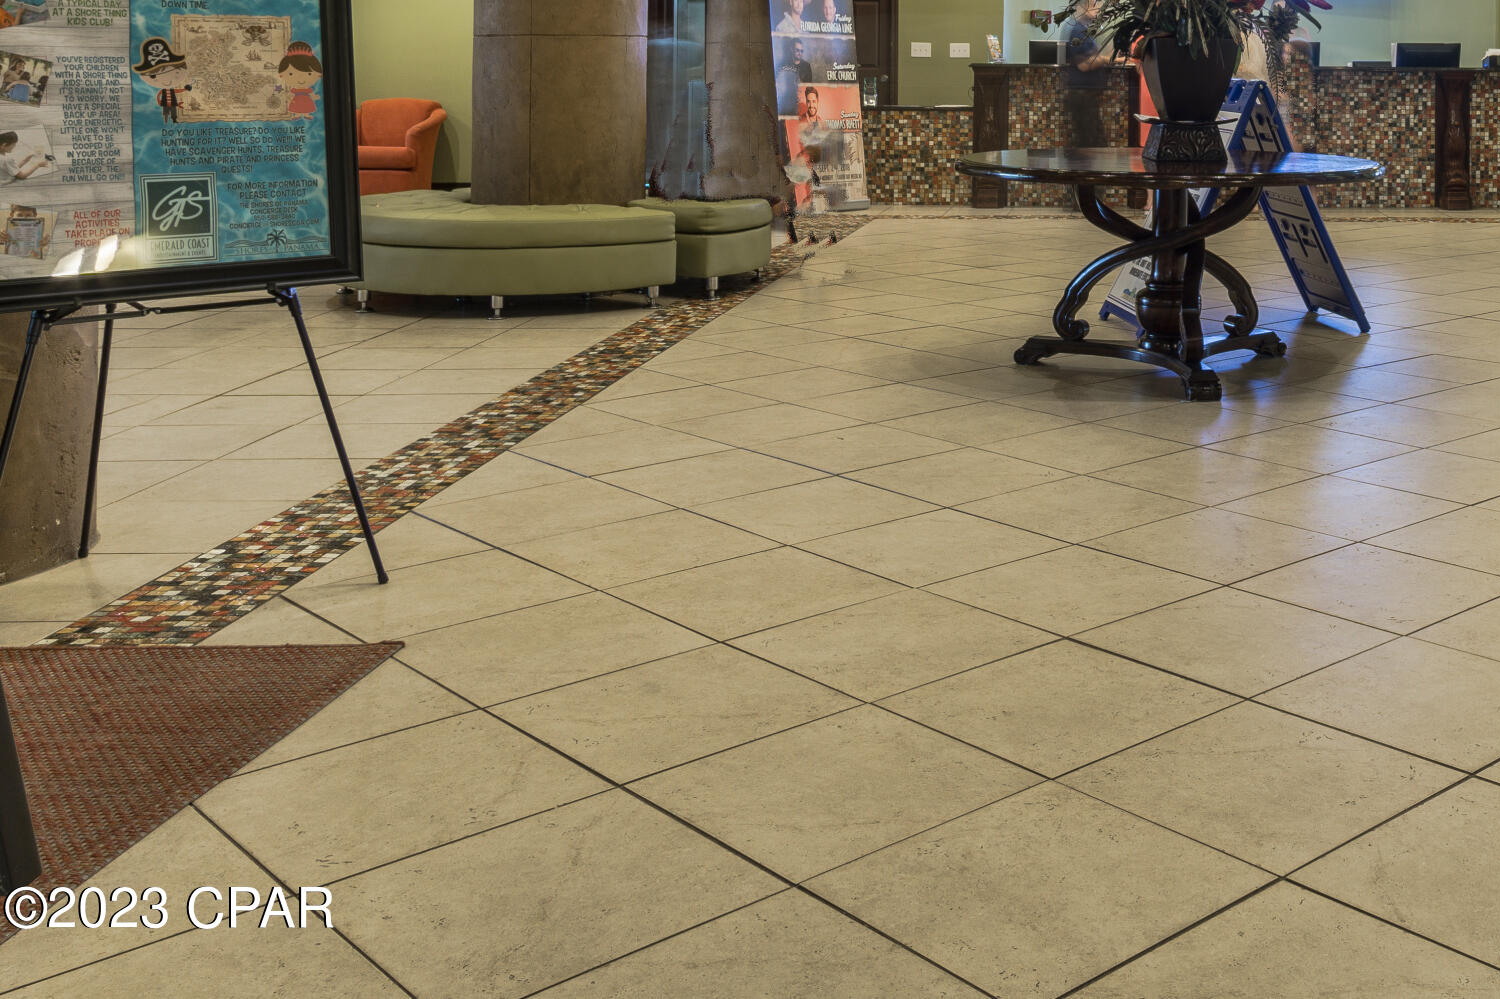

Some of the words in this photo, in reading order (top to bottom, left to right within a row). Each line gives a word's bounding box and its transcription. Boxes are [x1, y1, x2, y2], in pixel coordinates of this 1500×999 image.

[66, 0, 102, 8] TYPICAL
[53, 8, 64, 16] AT
[75, 8, 101, 17] SHORE
[67, 17, 87, 26] KIDS
[835, 14, 851, 23] Friday
[800, 21, 820, 32] FLORIDA
[821, 22, 841, 33] GEORGIA
[842, 24, 853, 33] LINE
[833, 62, 855, 70] Saturday
[827, 71, 837, 80] ERIC
[838, 71, 856, 80] CHURCH
[215, 127, 256, 135] TREASURE?
[162, 138, 195, 146] HUNTING
[170, 158, 196, 166] HUNTS
[199, 156, 214, 165] AND
[228, 183, 242, 192] FOR
[268, 179, 318, 188] INFORMATION
[74, 211, 88, 219] ALL
[104, 209, 120, 217] OUR
[76, 219, 120, 229] ACTIVITIES
[65, 230, 87, 239] TAKE
[89, 228, 116, 237] PLACE
